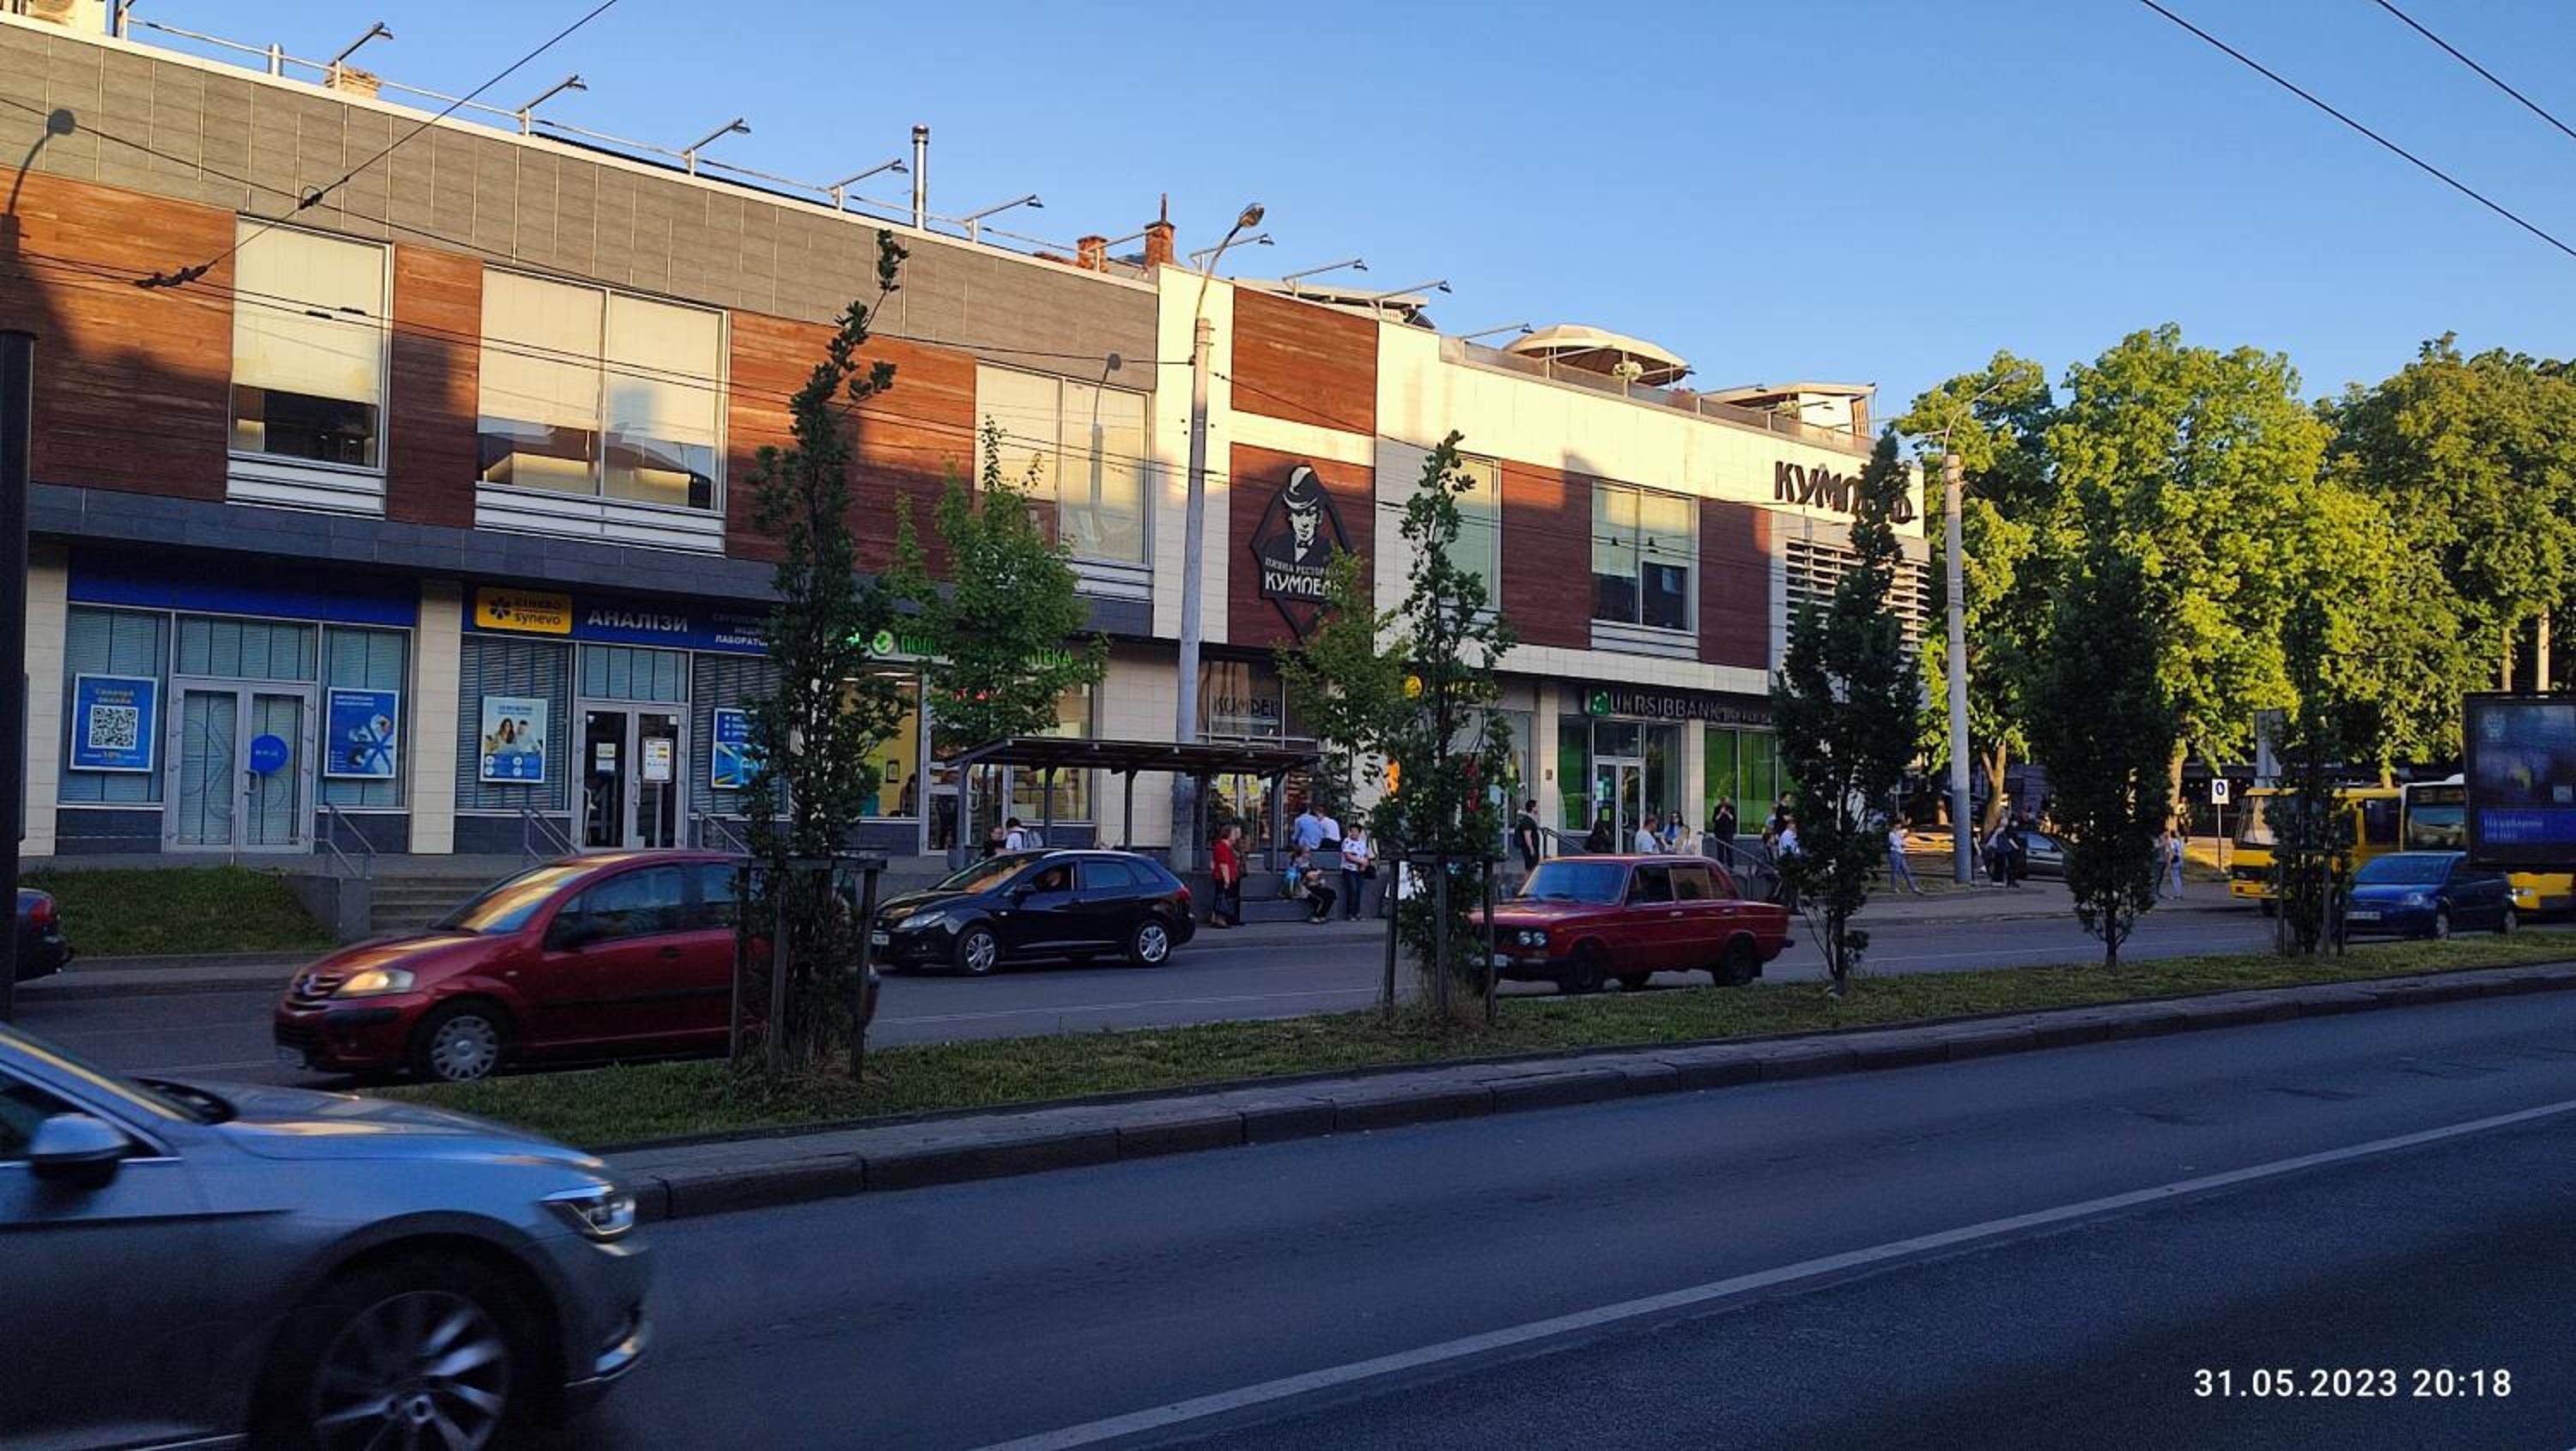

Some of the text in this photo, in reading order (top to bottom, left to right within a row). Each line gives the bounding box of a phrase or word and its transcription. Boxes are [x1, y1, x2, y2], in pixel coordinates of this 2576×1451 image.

[1774, 460, 1913, 525] КУМПЬ
[515, 614, 562, 626] synevo
[587, 609, 688, 633] АНАЛІЗИ
[1609, 692, 1719, 720] UKRSIBBANK
